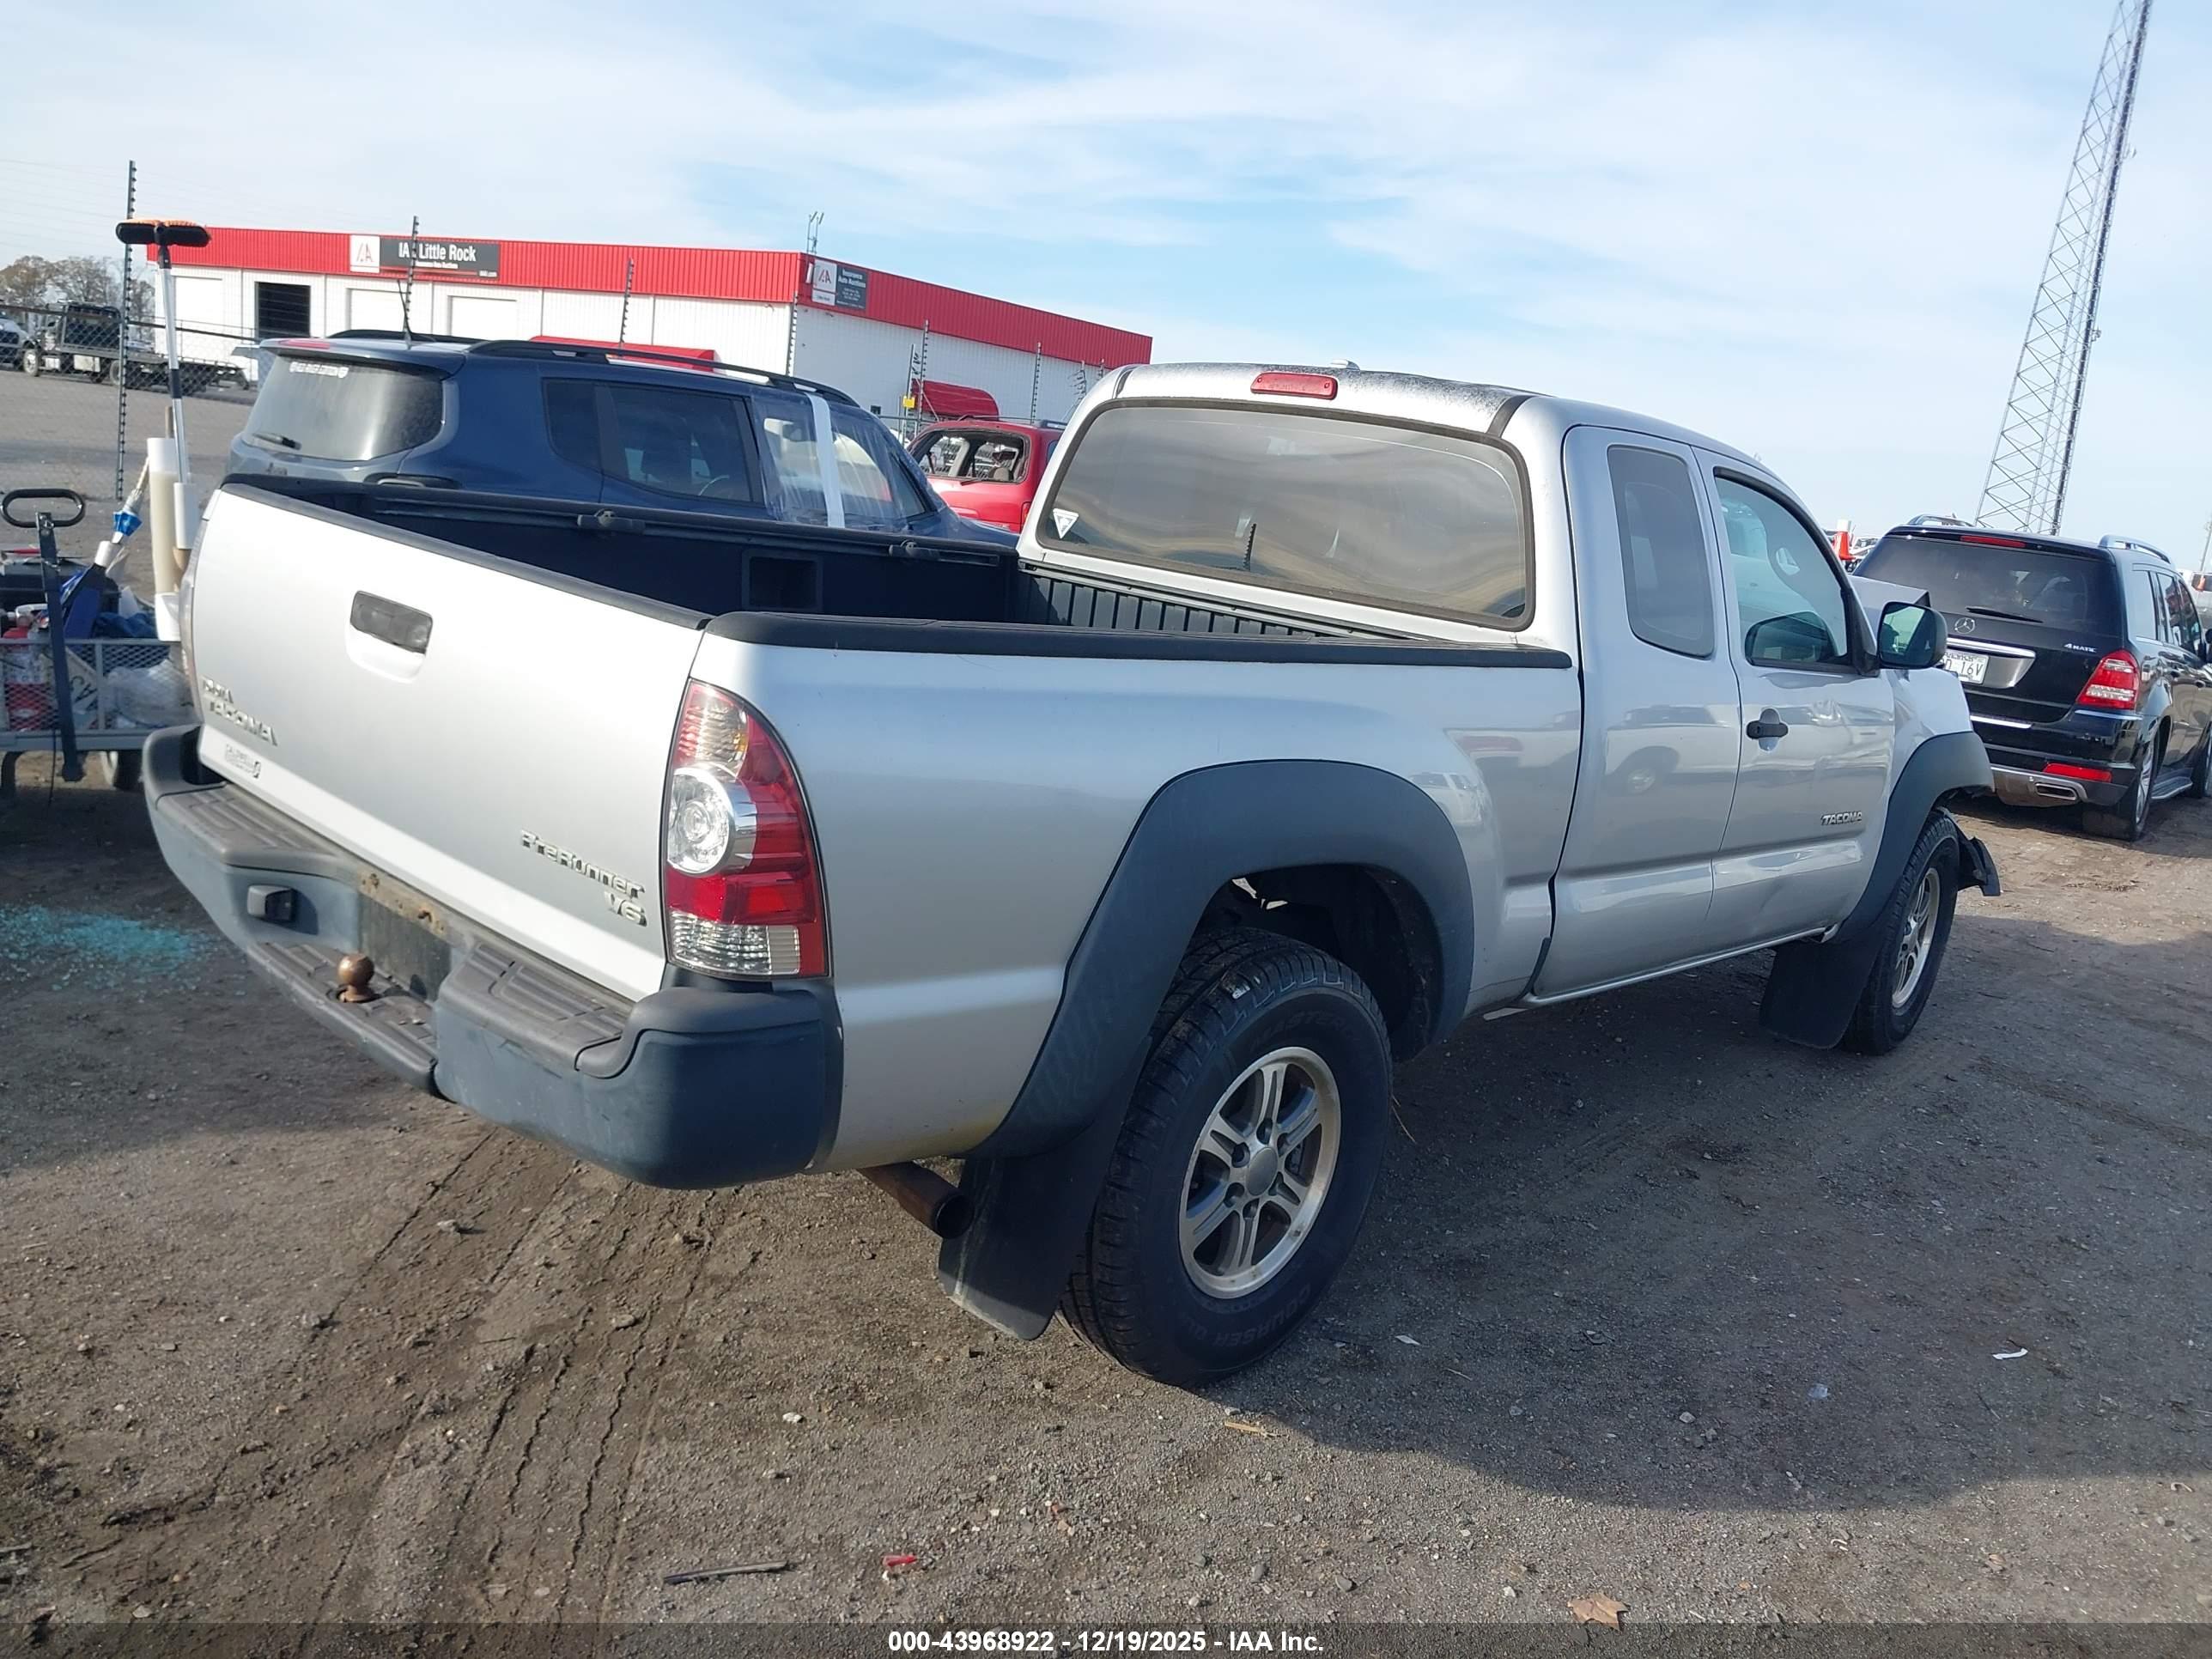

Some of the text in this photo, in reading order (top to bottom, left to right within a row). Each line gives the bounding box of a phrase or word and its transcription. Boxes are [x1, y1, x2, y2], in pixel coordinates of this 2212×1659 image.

[418, 243, 447, 260] Little
[448, 244, 477, 262] Rock
[209, 700, 278, 747] TACOMA
[1820, 811, 1863, 826] TACOMA
[520, 829, 646, 899] PreRunner
[605, 890, 647, 927] V6
